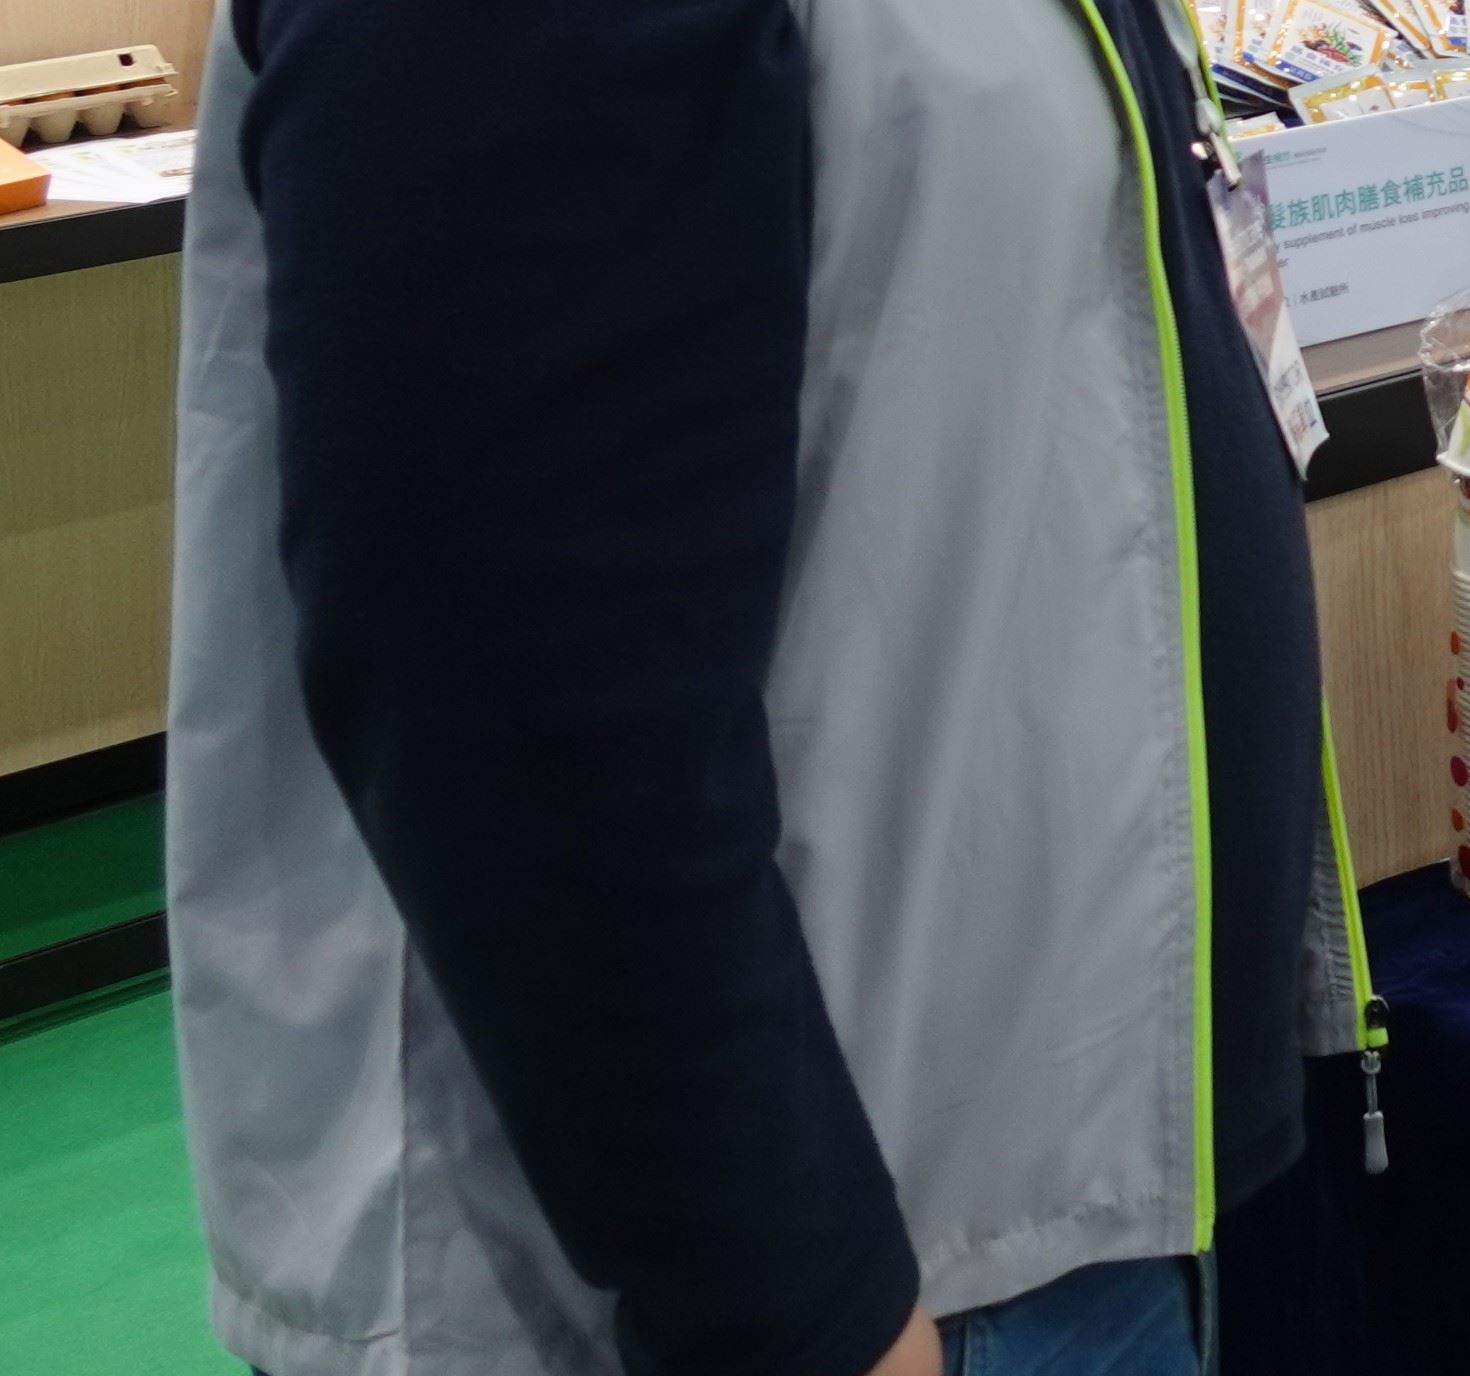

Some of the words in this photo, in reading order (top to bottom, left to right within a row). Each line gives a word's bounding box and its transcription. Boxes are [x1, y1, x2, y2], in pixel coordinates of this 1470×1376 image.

[1283, 226, 1344, 249] supplement
[1346, 223, 1358, 236] of
[1359, 216, 1396, 233] muscle
[1399, 210, 1420, 224] loss
